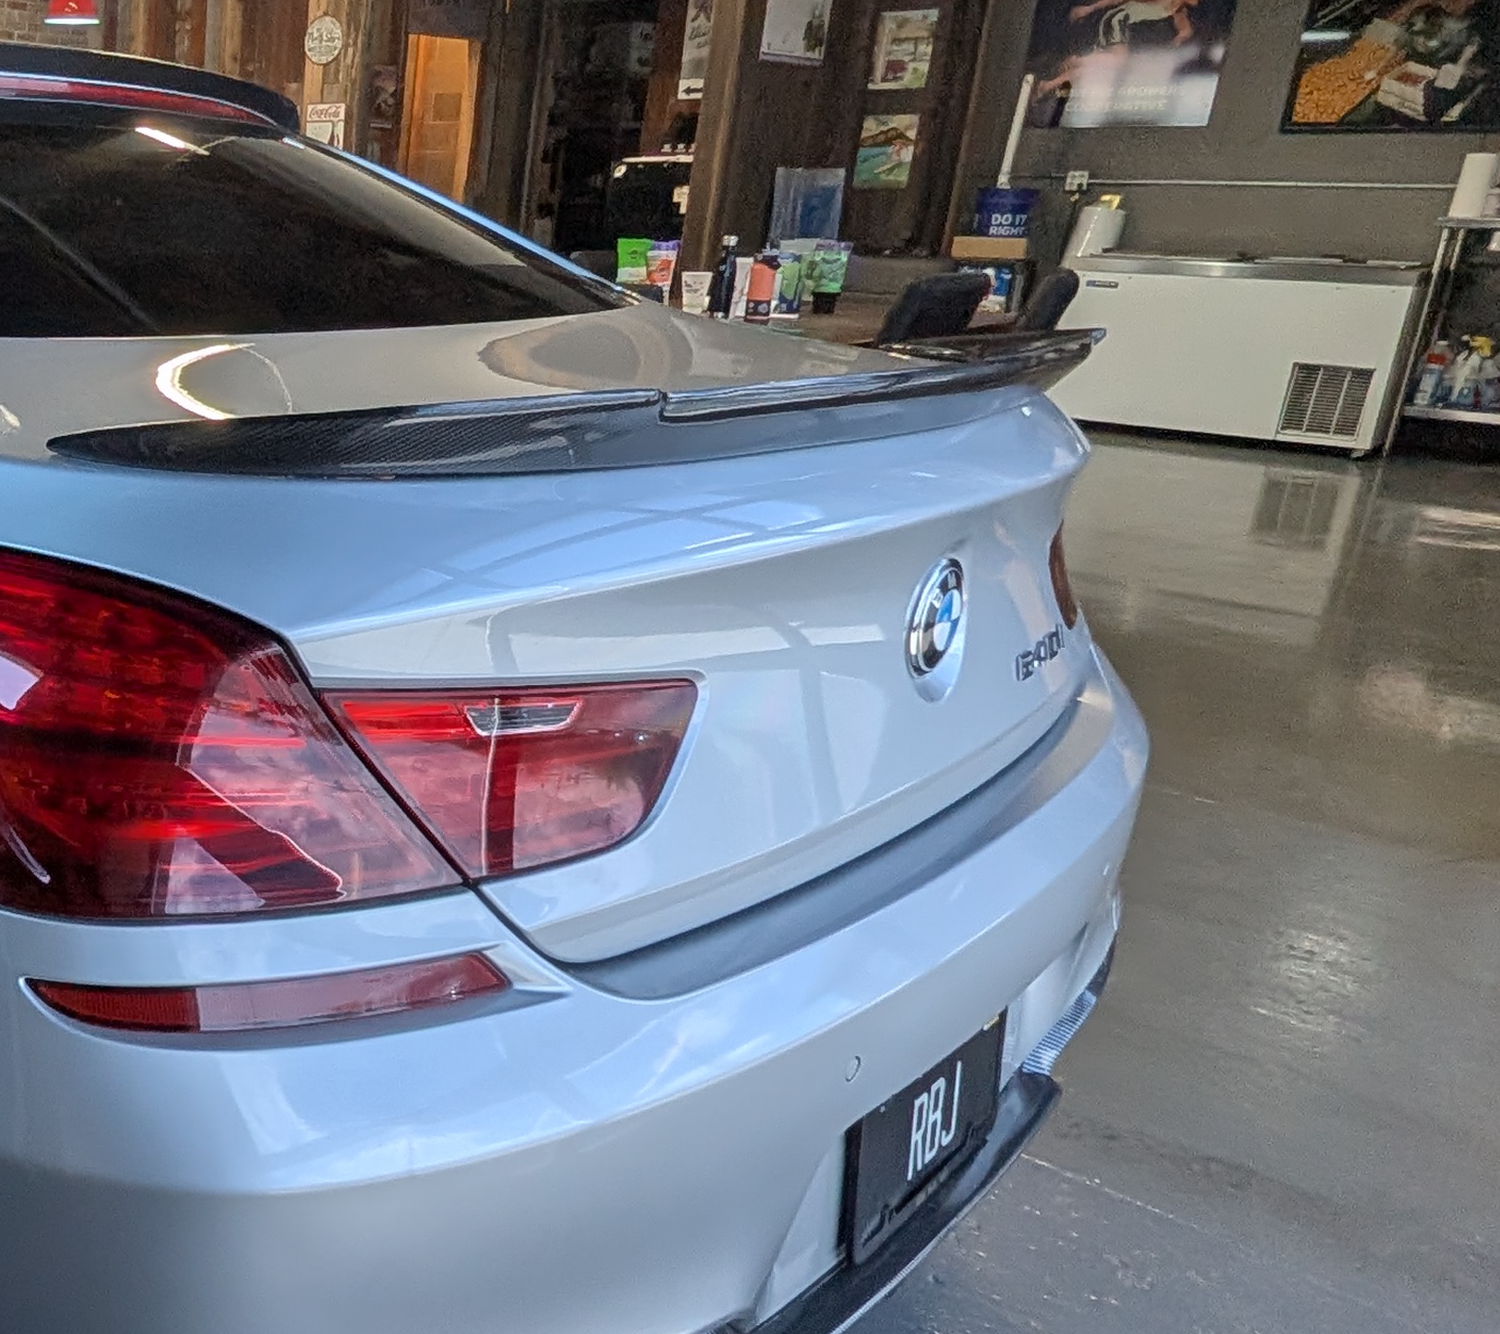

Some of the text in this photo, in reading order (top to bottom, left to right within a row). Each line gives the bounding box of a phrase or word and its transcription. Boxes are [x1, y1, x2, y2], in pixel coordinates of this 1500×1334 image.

[308, 104, 342, 120] Coca-Cola
[991, 213, 1012, 225] DO
[1014, 214, 1028, 226] IT
[907, 1060, 961, 1181] RBJ
